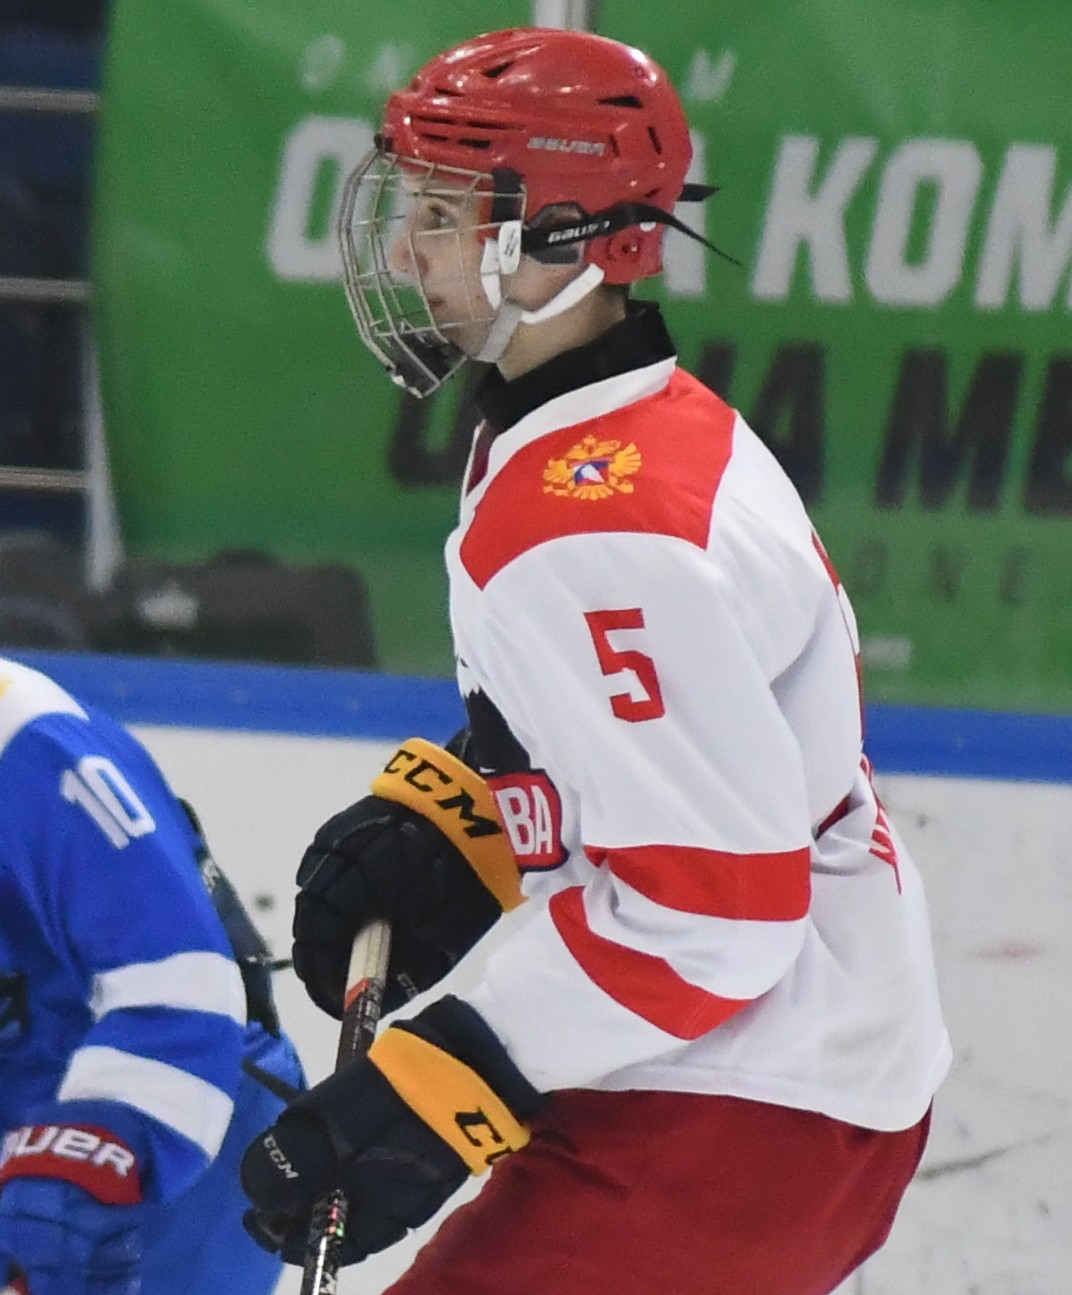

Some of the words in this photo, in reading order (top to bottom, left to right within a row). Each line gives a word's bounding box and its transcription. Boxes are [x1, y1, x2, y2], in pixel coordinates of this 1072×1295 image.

[584, 608, 666, 722] 5
[60, 755, 156, 850] 10
[383, 749, 504, 838] CCM
[263, 1134, 300, 1179] CCM
